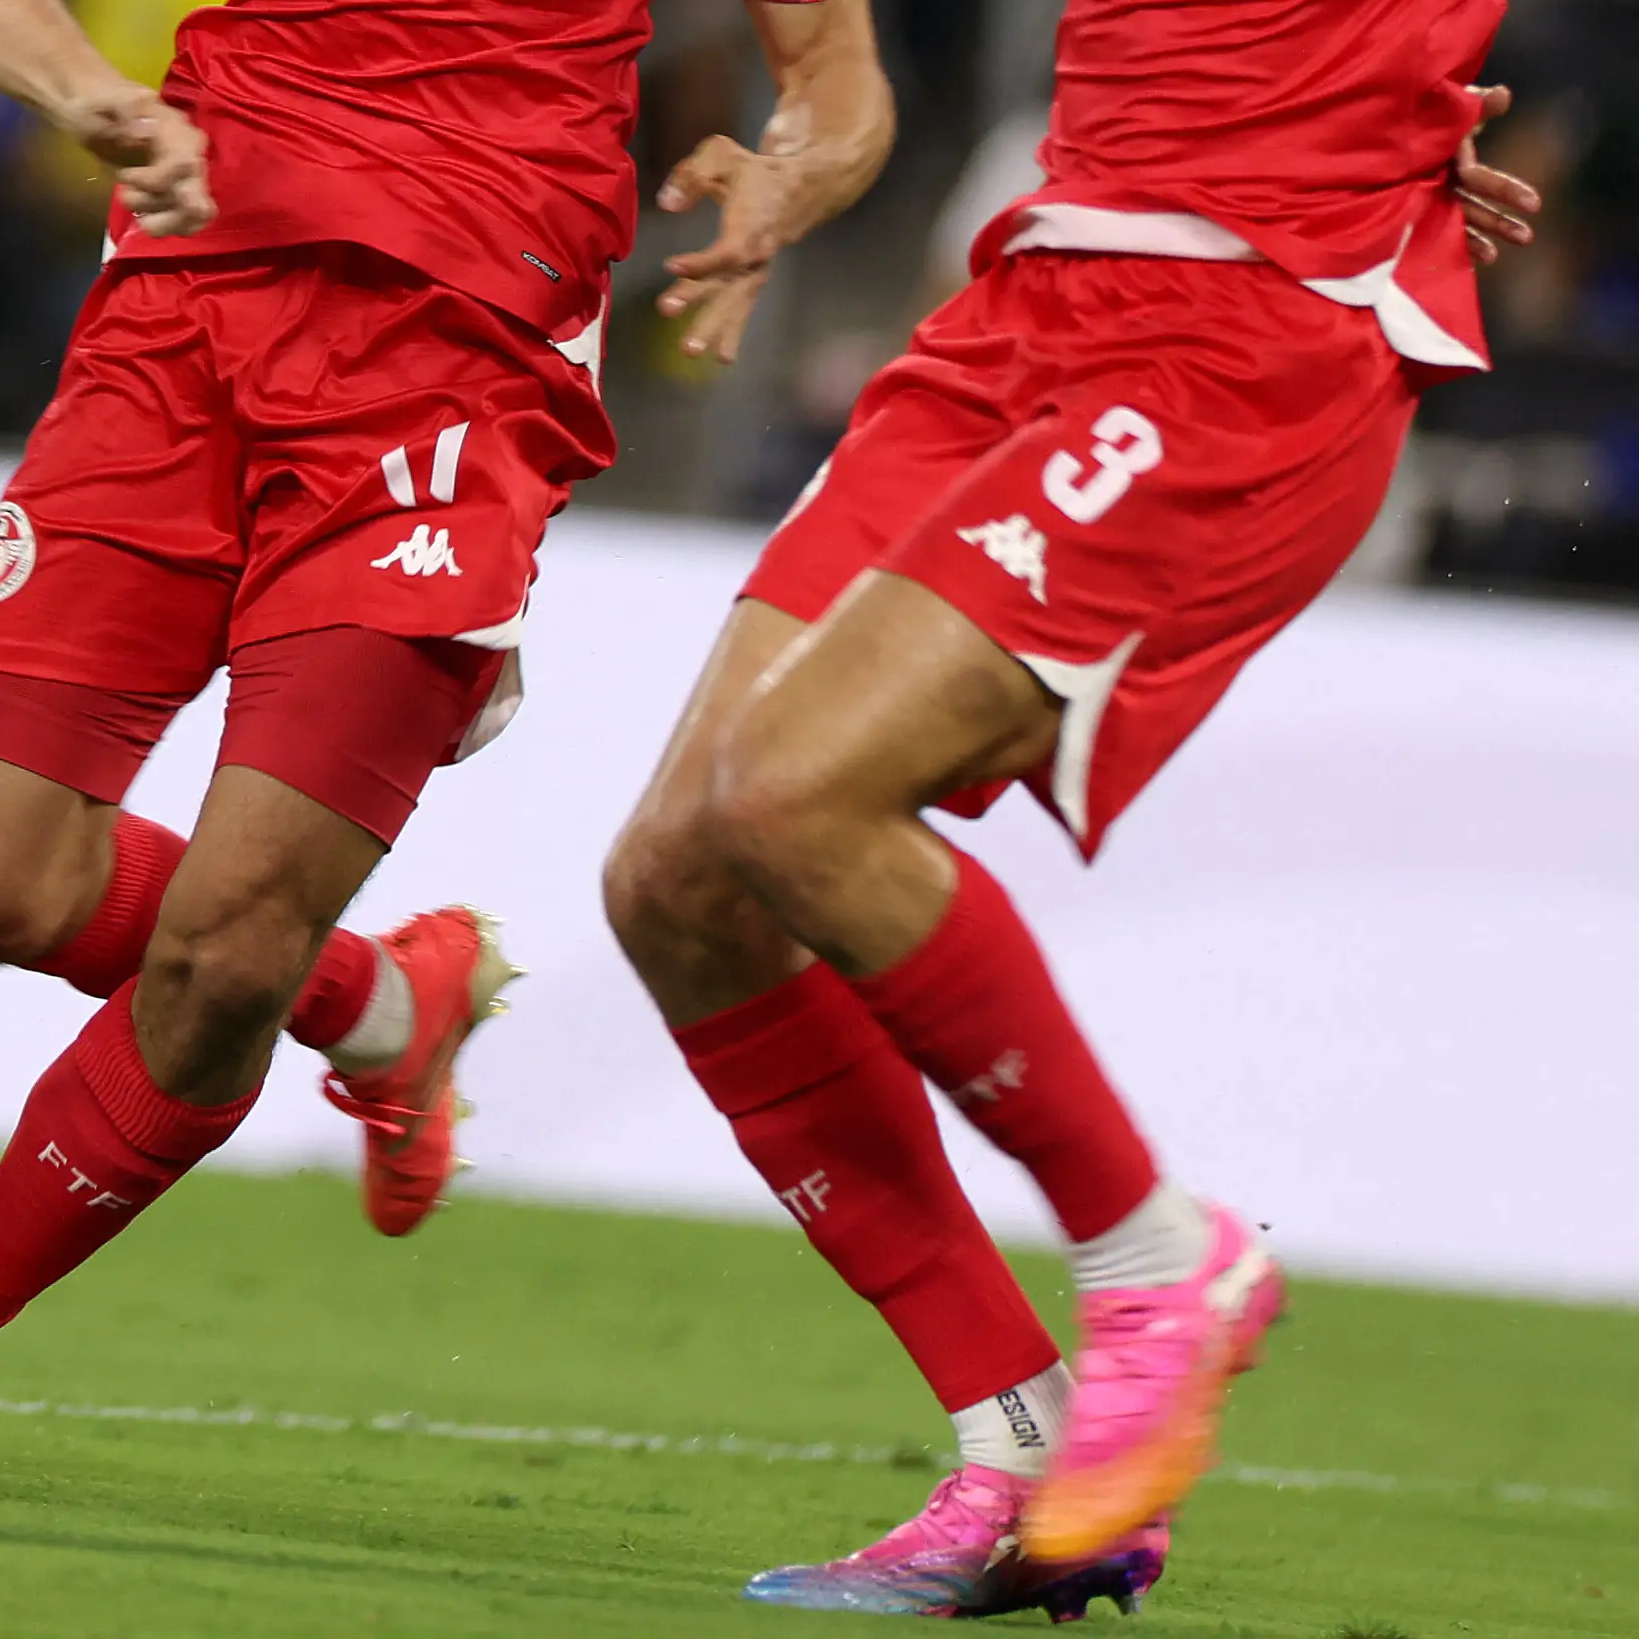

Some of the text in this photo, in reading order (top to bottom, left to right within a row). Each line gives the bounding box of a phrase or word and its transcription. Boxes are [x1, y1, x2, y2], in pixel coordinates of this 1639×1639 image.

[1042, 406, 1164, 524] 3
[36, 1140, 133, 1210] FTF
[780, 1168, 832, 1222] TF
